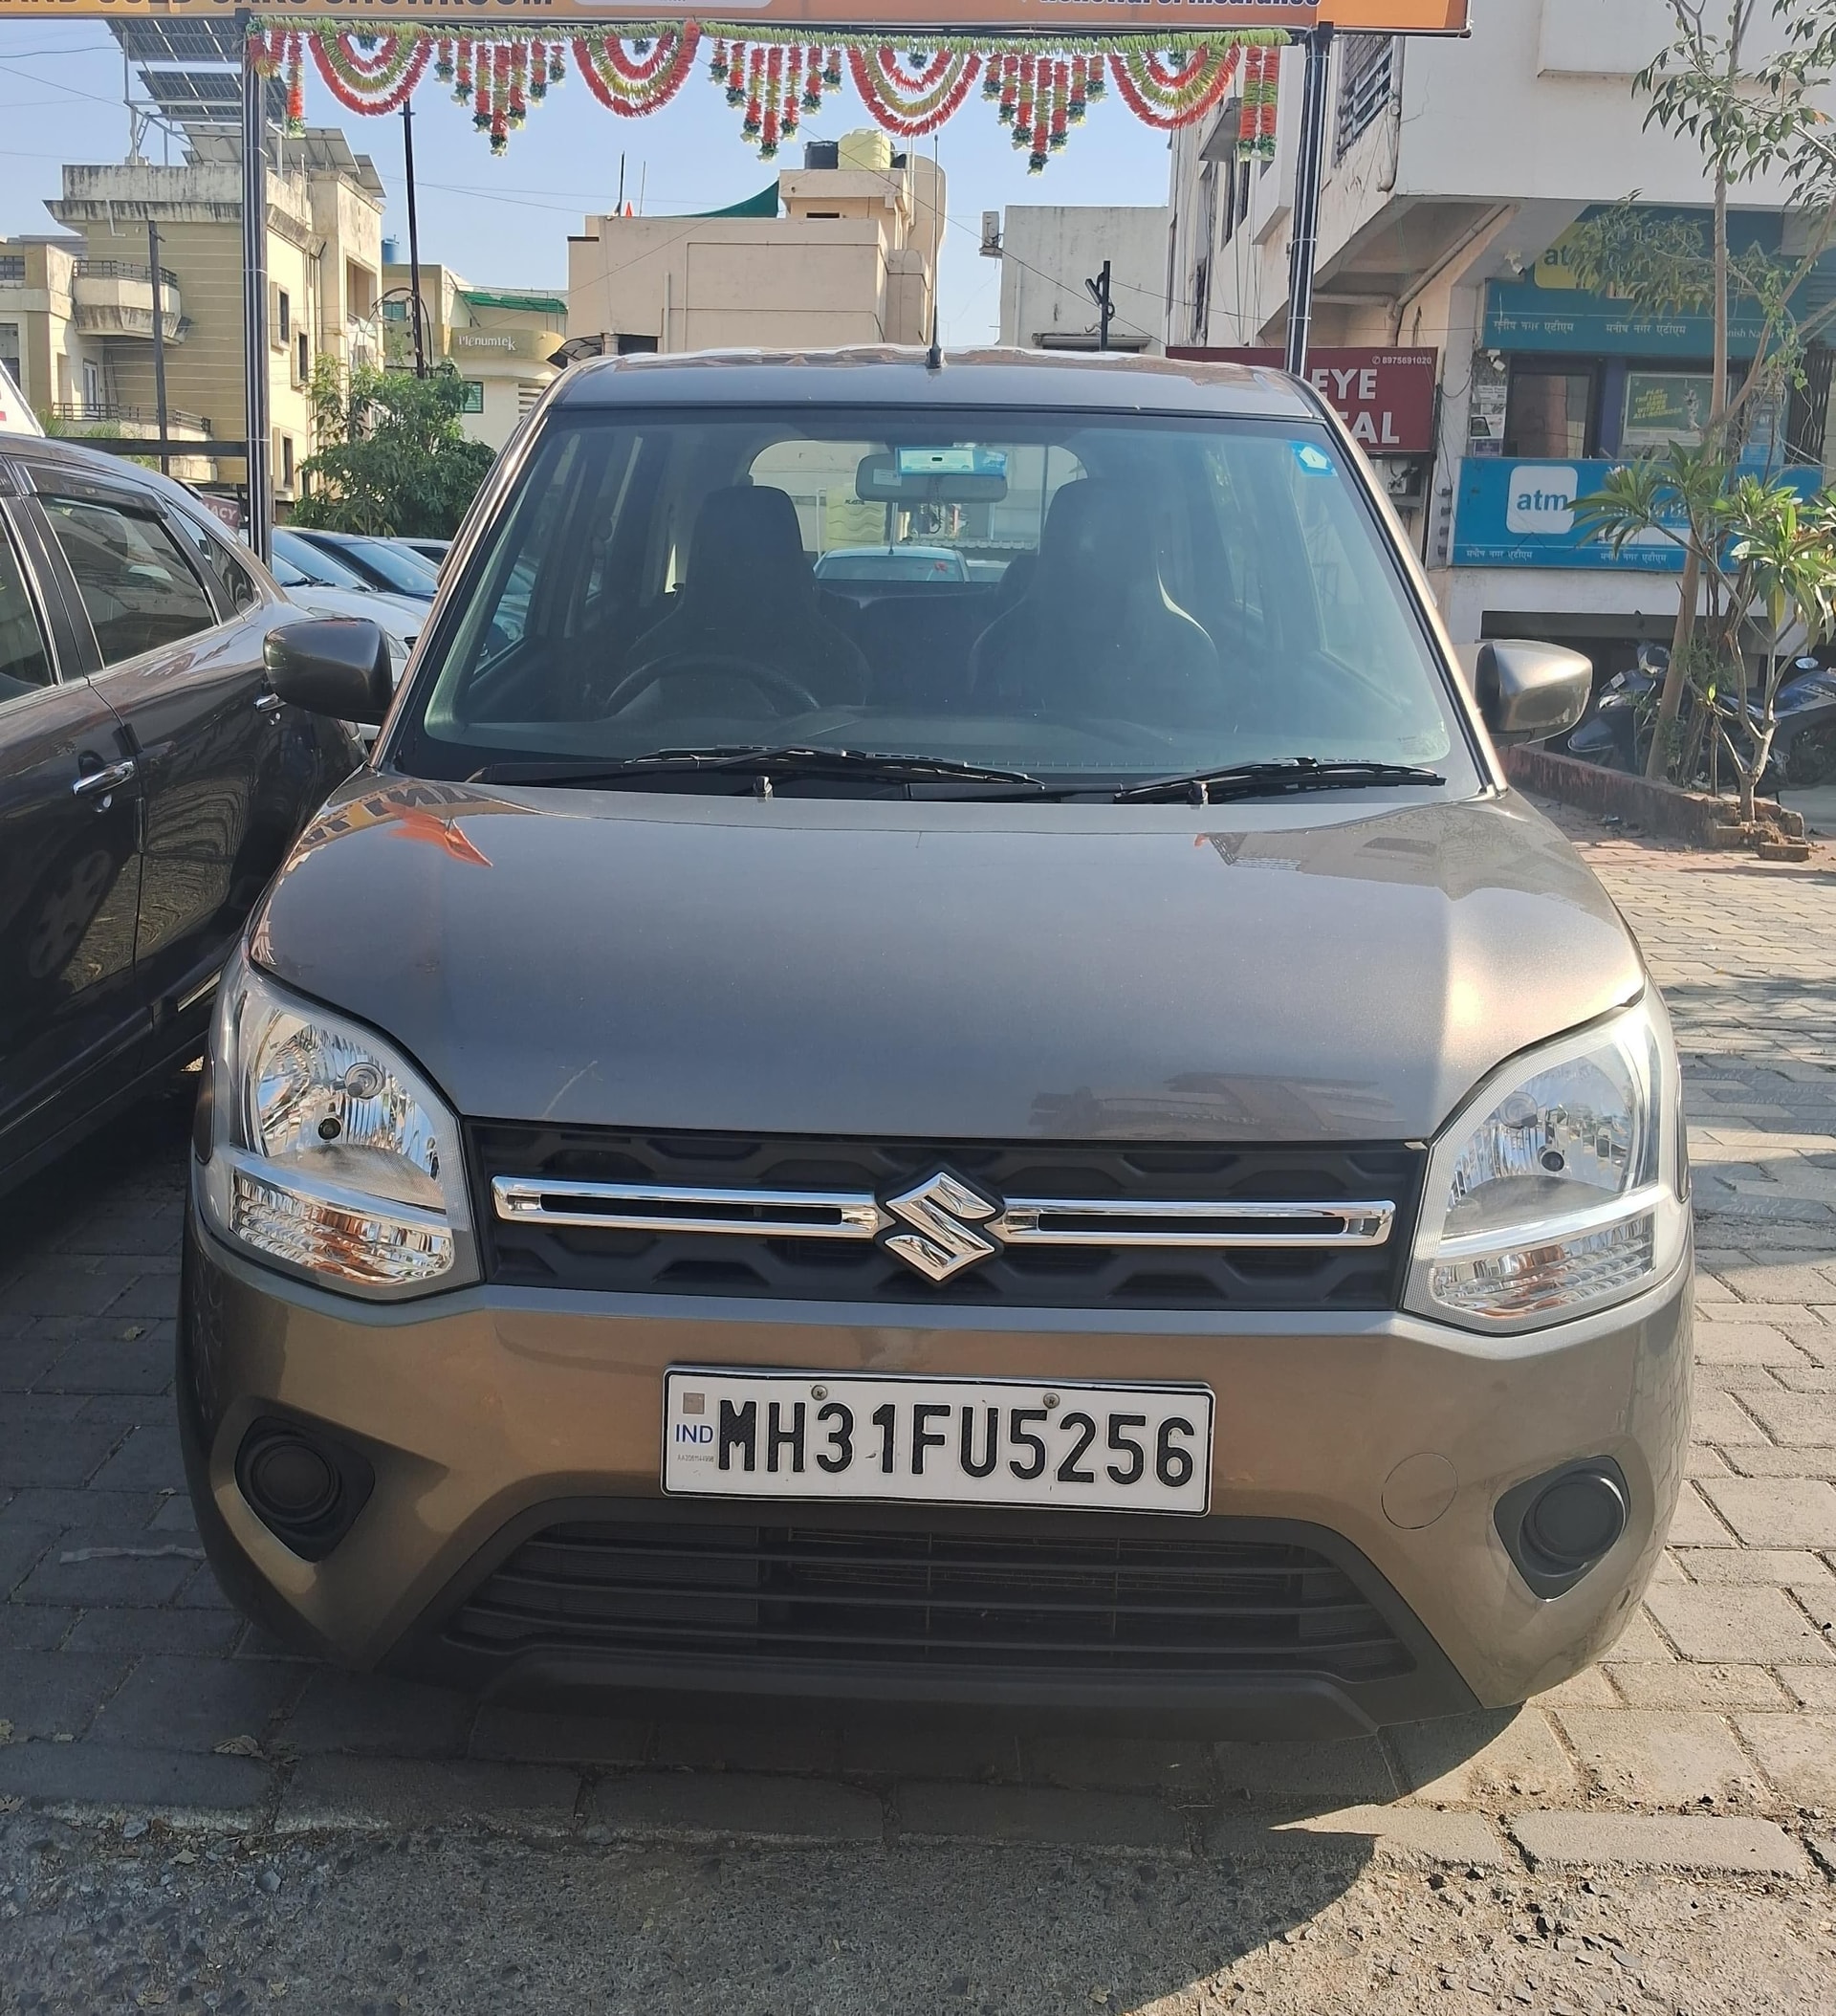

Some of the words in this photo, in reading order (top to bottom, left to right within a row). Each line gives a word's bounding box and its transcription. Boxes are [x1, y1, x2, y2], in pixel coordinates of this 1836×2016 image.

[1311, 368, 1377, 400] EYE
[1337, 411, 1400, 444] AL
[205, 504, 237, 520] ACY
[1517, 489, 1569, 511] atm
[675, 1423, 714, 1444] IND
[717, 1398, 1195, 1488] MH31FU5256
